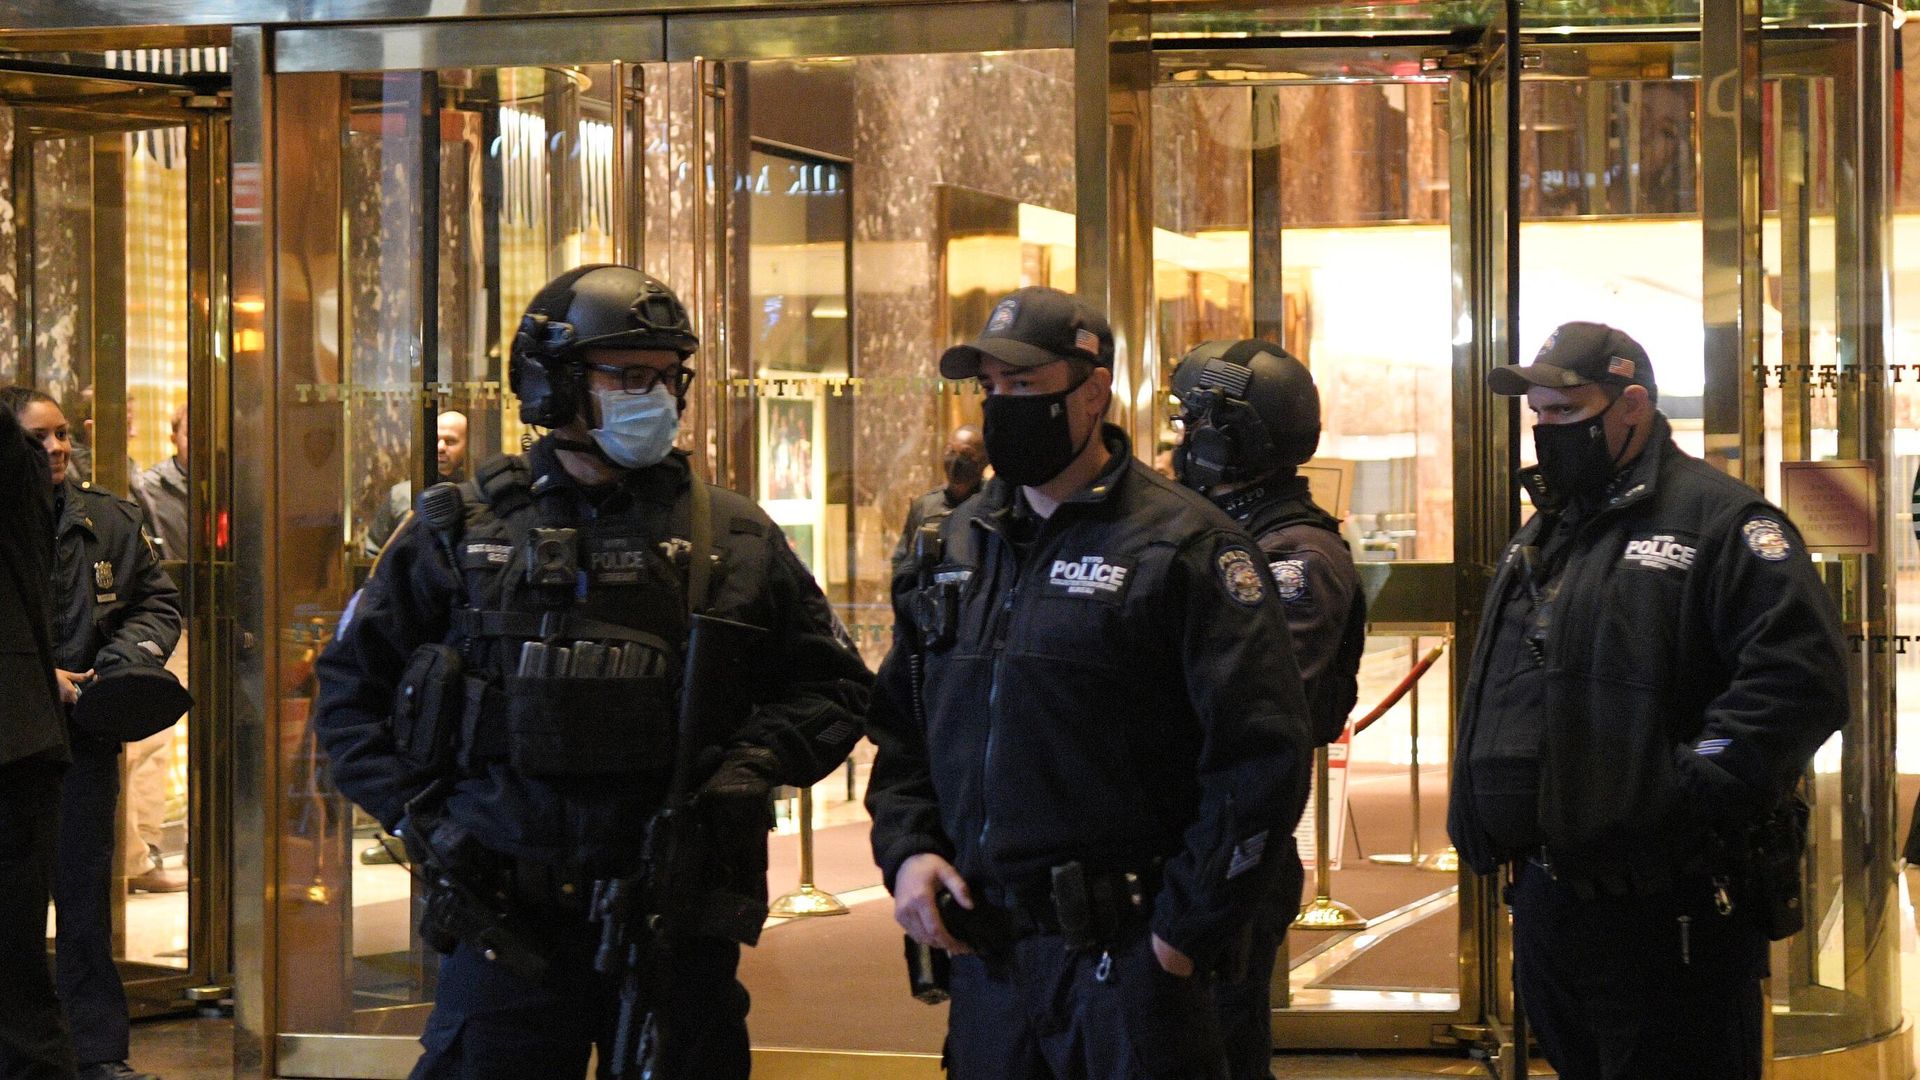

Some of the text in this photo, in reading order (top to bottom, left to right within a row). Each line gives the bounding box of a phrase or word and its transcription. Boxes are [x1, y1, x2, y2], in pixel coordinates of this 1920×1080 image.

[592, 551, 643, 569] POLICE
[1625, 540, 1697, 565] POLICE
[1050, 560, 1128, 586] POLICE
